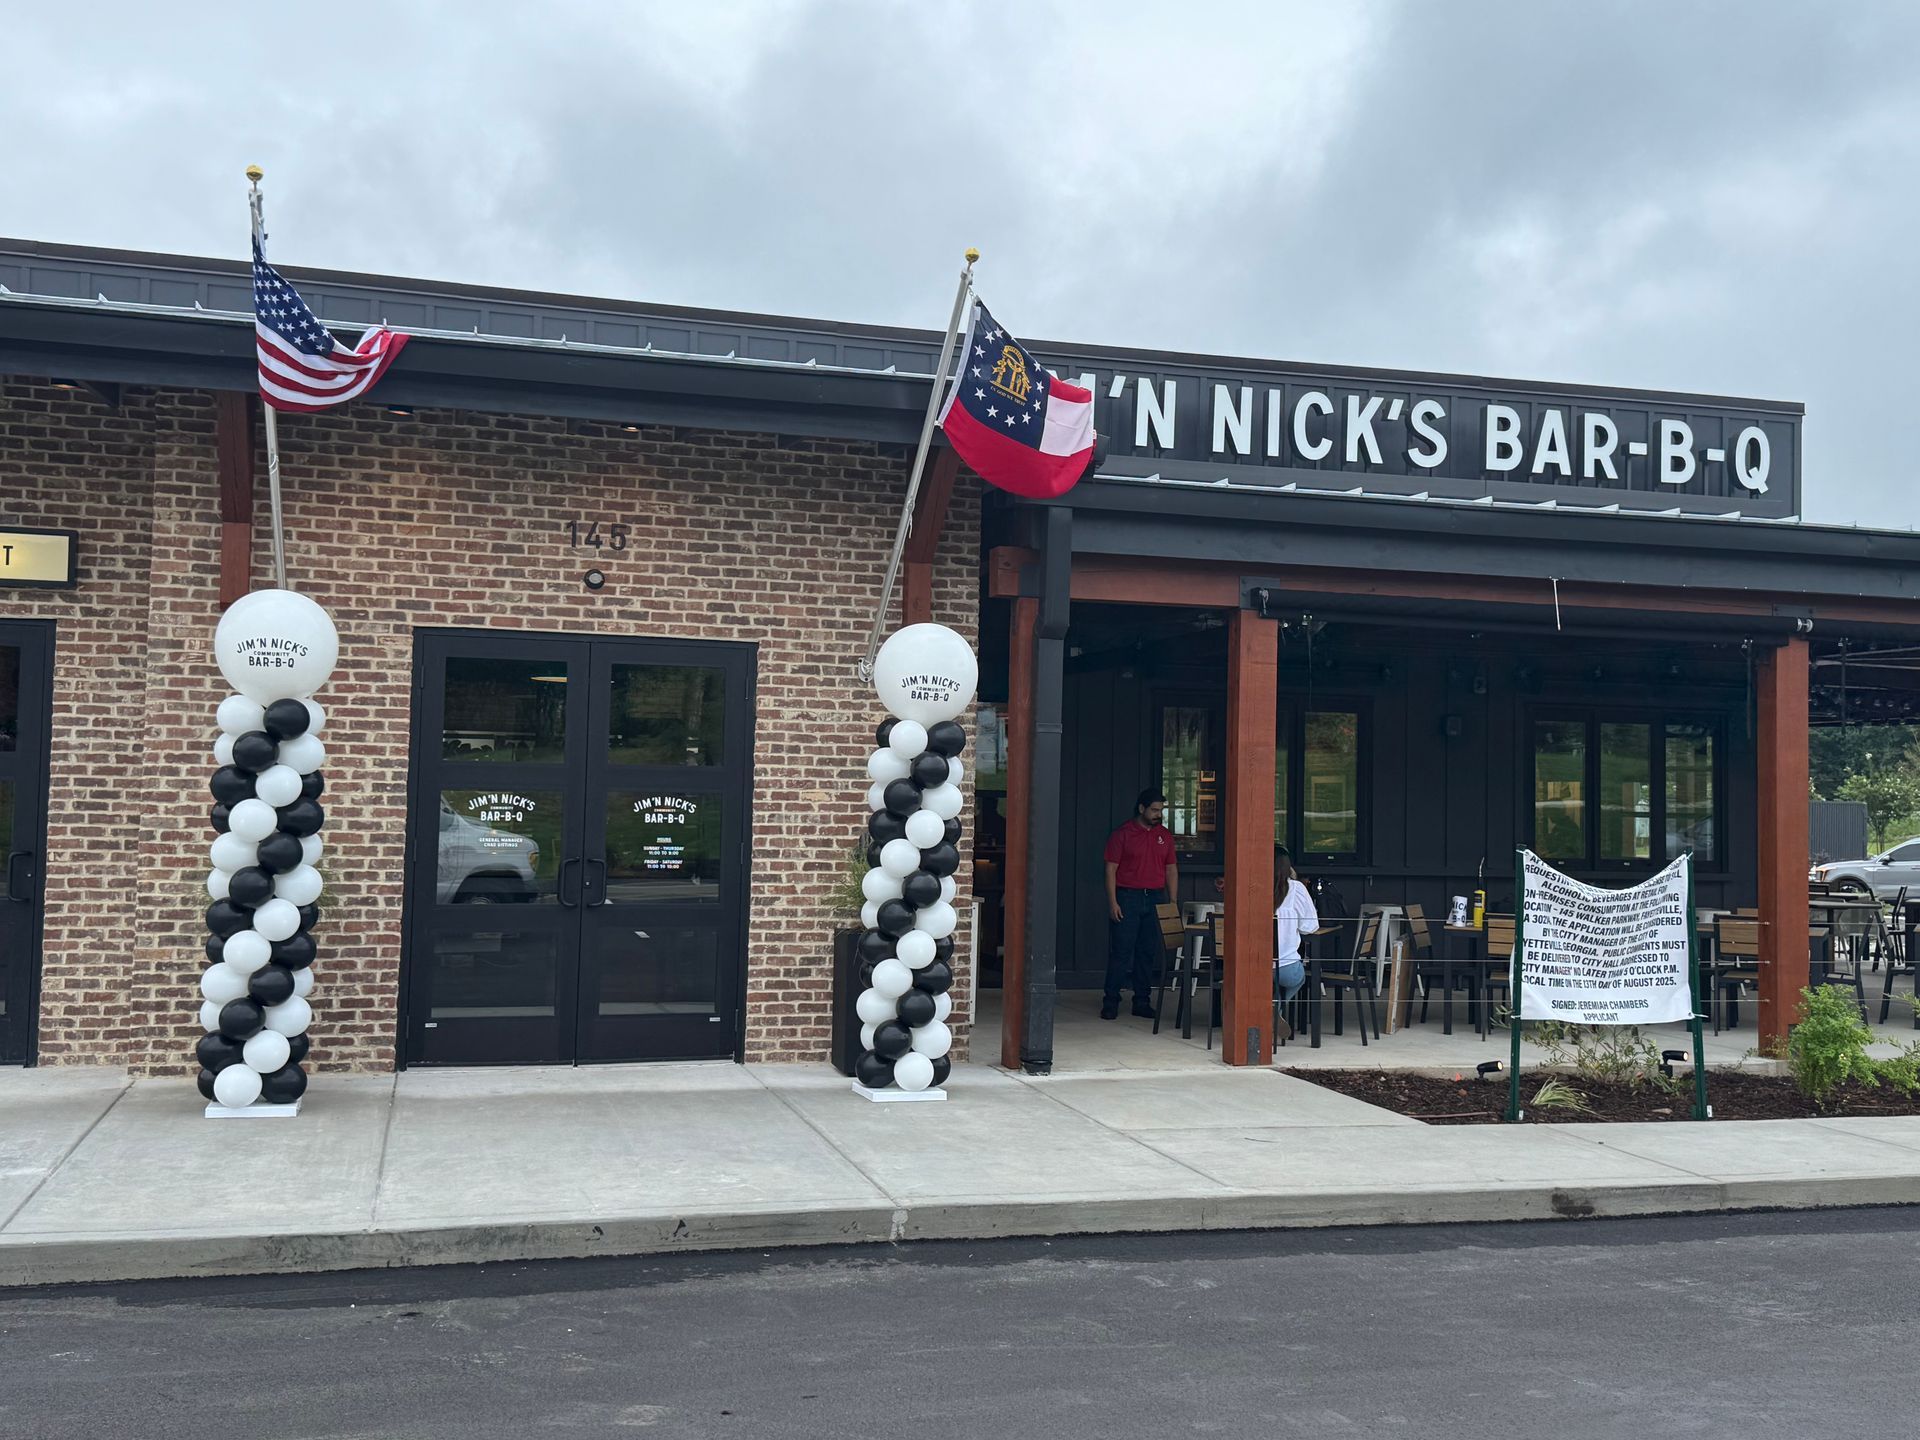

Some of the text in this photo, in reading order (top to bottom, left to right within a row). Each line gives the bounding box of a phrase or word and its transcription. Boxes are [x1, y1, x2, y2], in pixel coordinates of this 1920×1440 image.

[1211, 383, 1449, 469] NICK'S
[1485, 404, 1771, 495] BAR-B-Q
[566, 519, 628, 551] 145
[236, 637, 309, 658] JIM'N NICK'S
[248, 656, 295, 668] BAR-B-Q
[901, 675, 961, 692] JIM'N NICK'S
[910, 690, 950, 702] BAR-B-Q
[468, 793, 536, 811] JIM'N NICK'S
[633, 796, 697, 814] JIM'N NICK'S
[480, 810, 523, 822] BAR-B-Q
[644, 813, 685, 824] BAR-B-Q
[1632, 892, 1641, 900] AT
[1577, 903, 1630, 914] CONSUMPTION
[1630, 902, 1640, 912] AT
[1639, 900, 1650, 910] THE
[1559, 908, 1575, 918] 145
[1576, 911, 1610, 925] WALKER
[1552, 916, 1568, 928] THE
[1568, 921, 1620, 936] APPLICATION
[1621, 924, 1634, 934] WILL
[1635, 923, 1644, 932] BE
[1559, 930, 1580, 941] CITY
[1579, 934, 1619, 947] MANAGER
[1618, 936, 1628, 946] OF
[1628, 934, 1638, 943] THE
[1648, 929, 1659, 938] OF
[1562, 941, 1599, 957] GEORGIA.
[1602, 948, 1626, 958] PUBLIC
[1662, 940, 1687, 950] MUST
[1527, 950, 1540, 960] BE
[1571, 954, 1581, 964] TO
[1582, 957, 1602, 968] CITY
[1602, 958, 1620, 968] HALL
[1620, 953, 1658, 967] ADDRESSED
[1659, 952, 1670, 962] TO
[1582, 967, 1607, 979] LATER
[1607, 967, 1624, 979] THAN
[1623, 967, 1629, 976] 5
[1629, 965, 1662, 976] O'CLOCK
[1663, 964, 1680, 974] P.M.
[1548, 978, 1565, 988] TIME
[1572, 979, 1582, 989] THE
[1583, 979, 1597, 989] 13TH
[1598, 980, 1612, 990] DAY
[1612, 980, 1622, 989] OF
[1624, 977, 1654, 988] AUGUST
[1655, 976, 1677, 986] 2025.
[1551, 999, 1650, 1010] SIGNED: JEREMIAH CHAMBERS
[1583, 1012, 1620, 1022] APPLICANT
